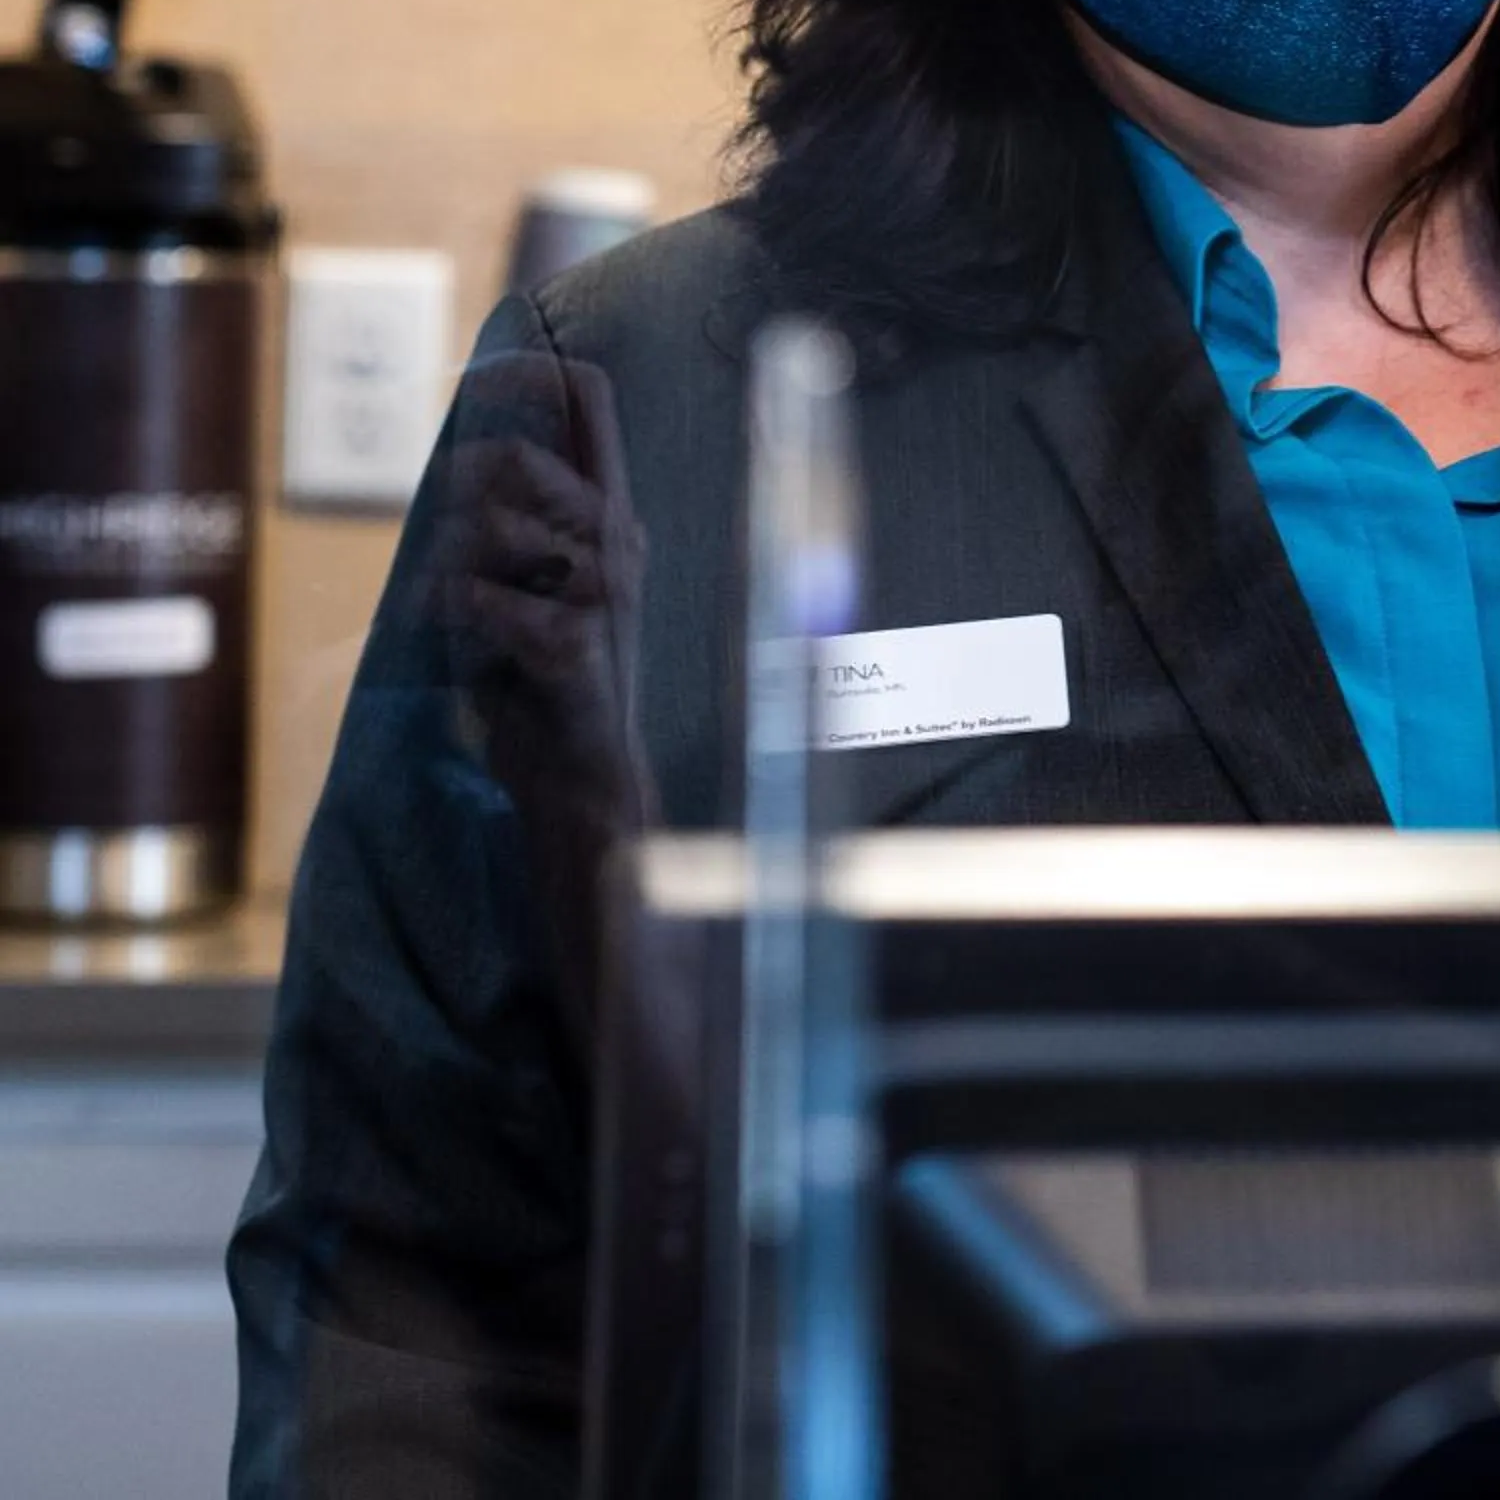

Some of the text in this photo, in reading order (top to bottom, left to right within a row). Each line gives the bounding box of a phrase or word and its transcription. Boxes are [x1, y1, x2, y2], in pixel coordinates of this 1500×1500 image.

[827, 663, 883, 682] TINA
[829, 732, 877, 742] Country
[881, 728, 899, 736] Inn
[904, 726, 912, 734] &
[961, 719, 976, 730] by
